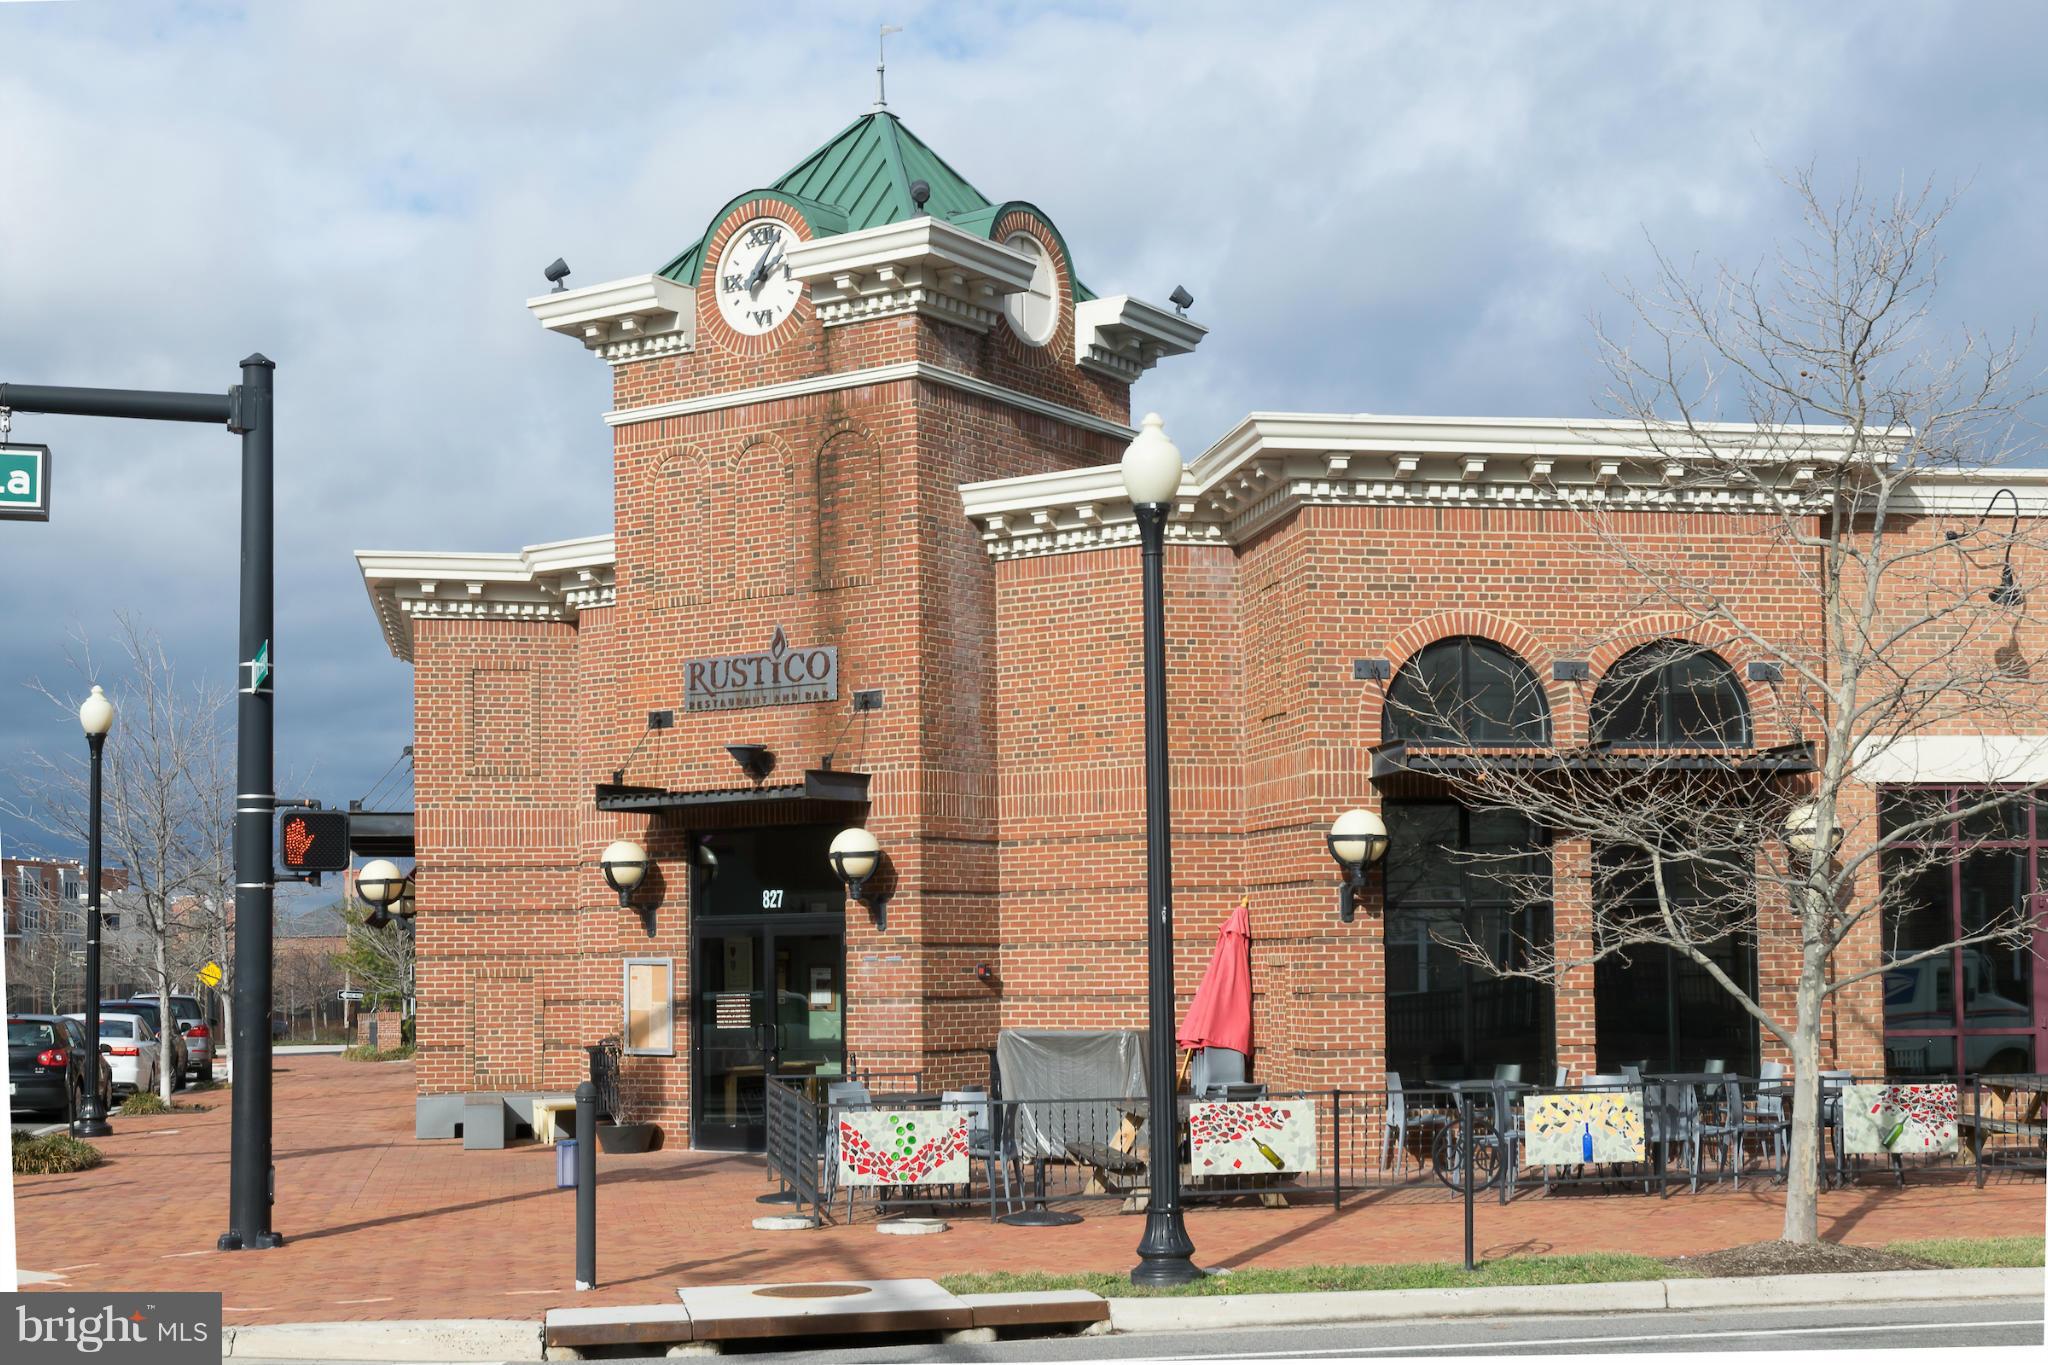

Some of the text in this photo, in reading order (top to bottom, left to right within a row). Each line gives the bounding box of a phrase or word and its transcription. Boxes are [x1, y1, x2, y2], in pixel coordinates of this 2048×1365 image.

[723, 274, 744, 293] IX
[752, 309, 773, 328] VI
[0, 470, 30, 494] a
[689, 690, 829, 710] RESTAURANT AND BAR
[762, 890, 784, 908] 827
